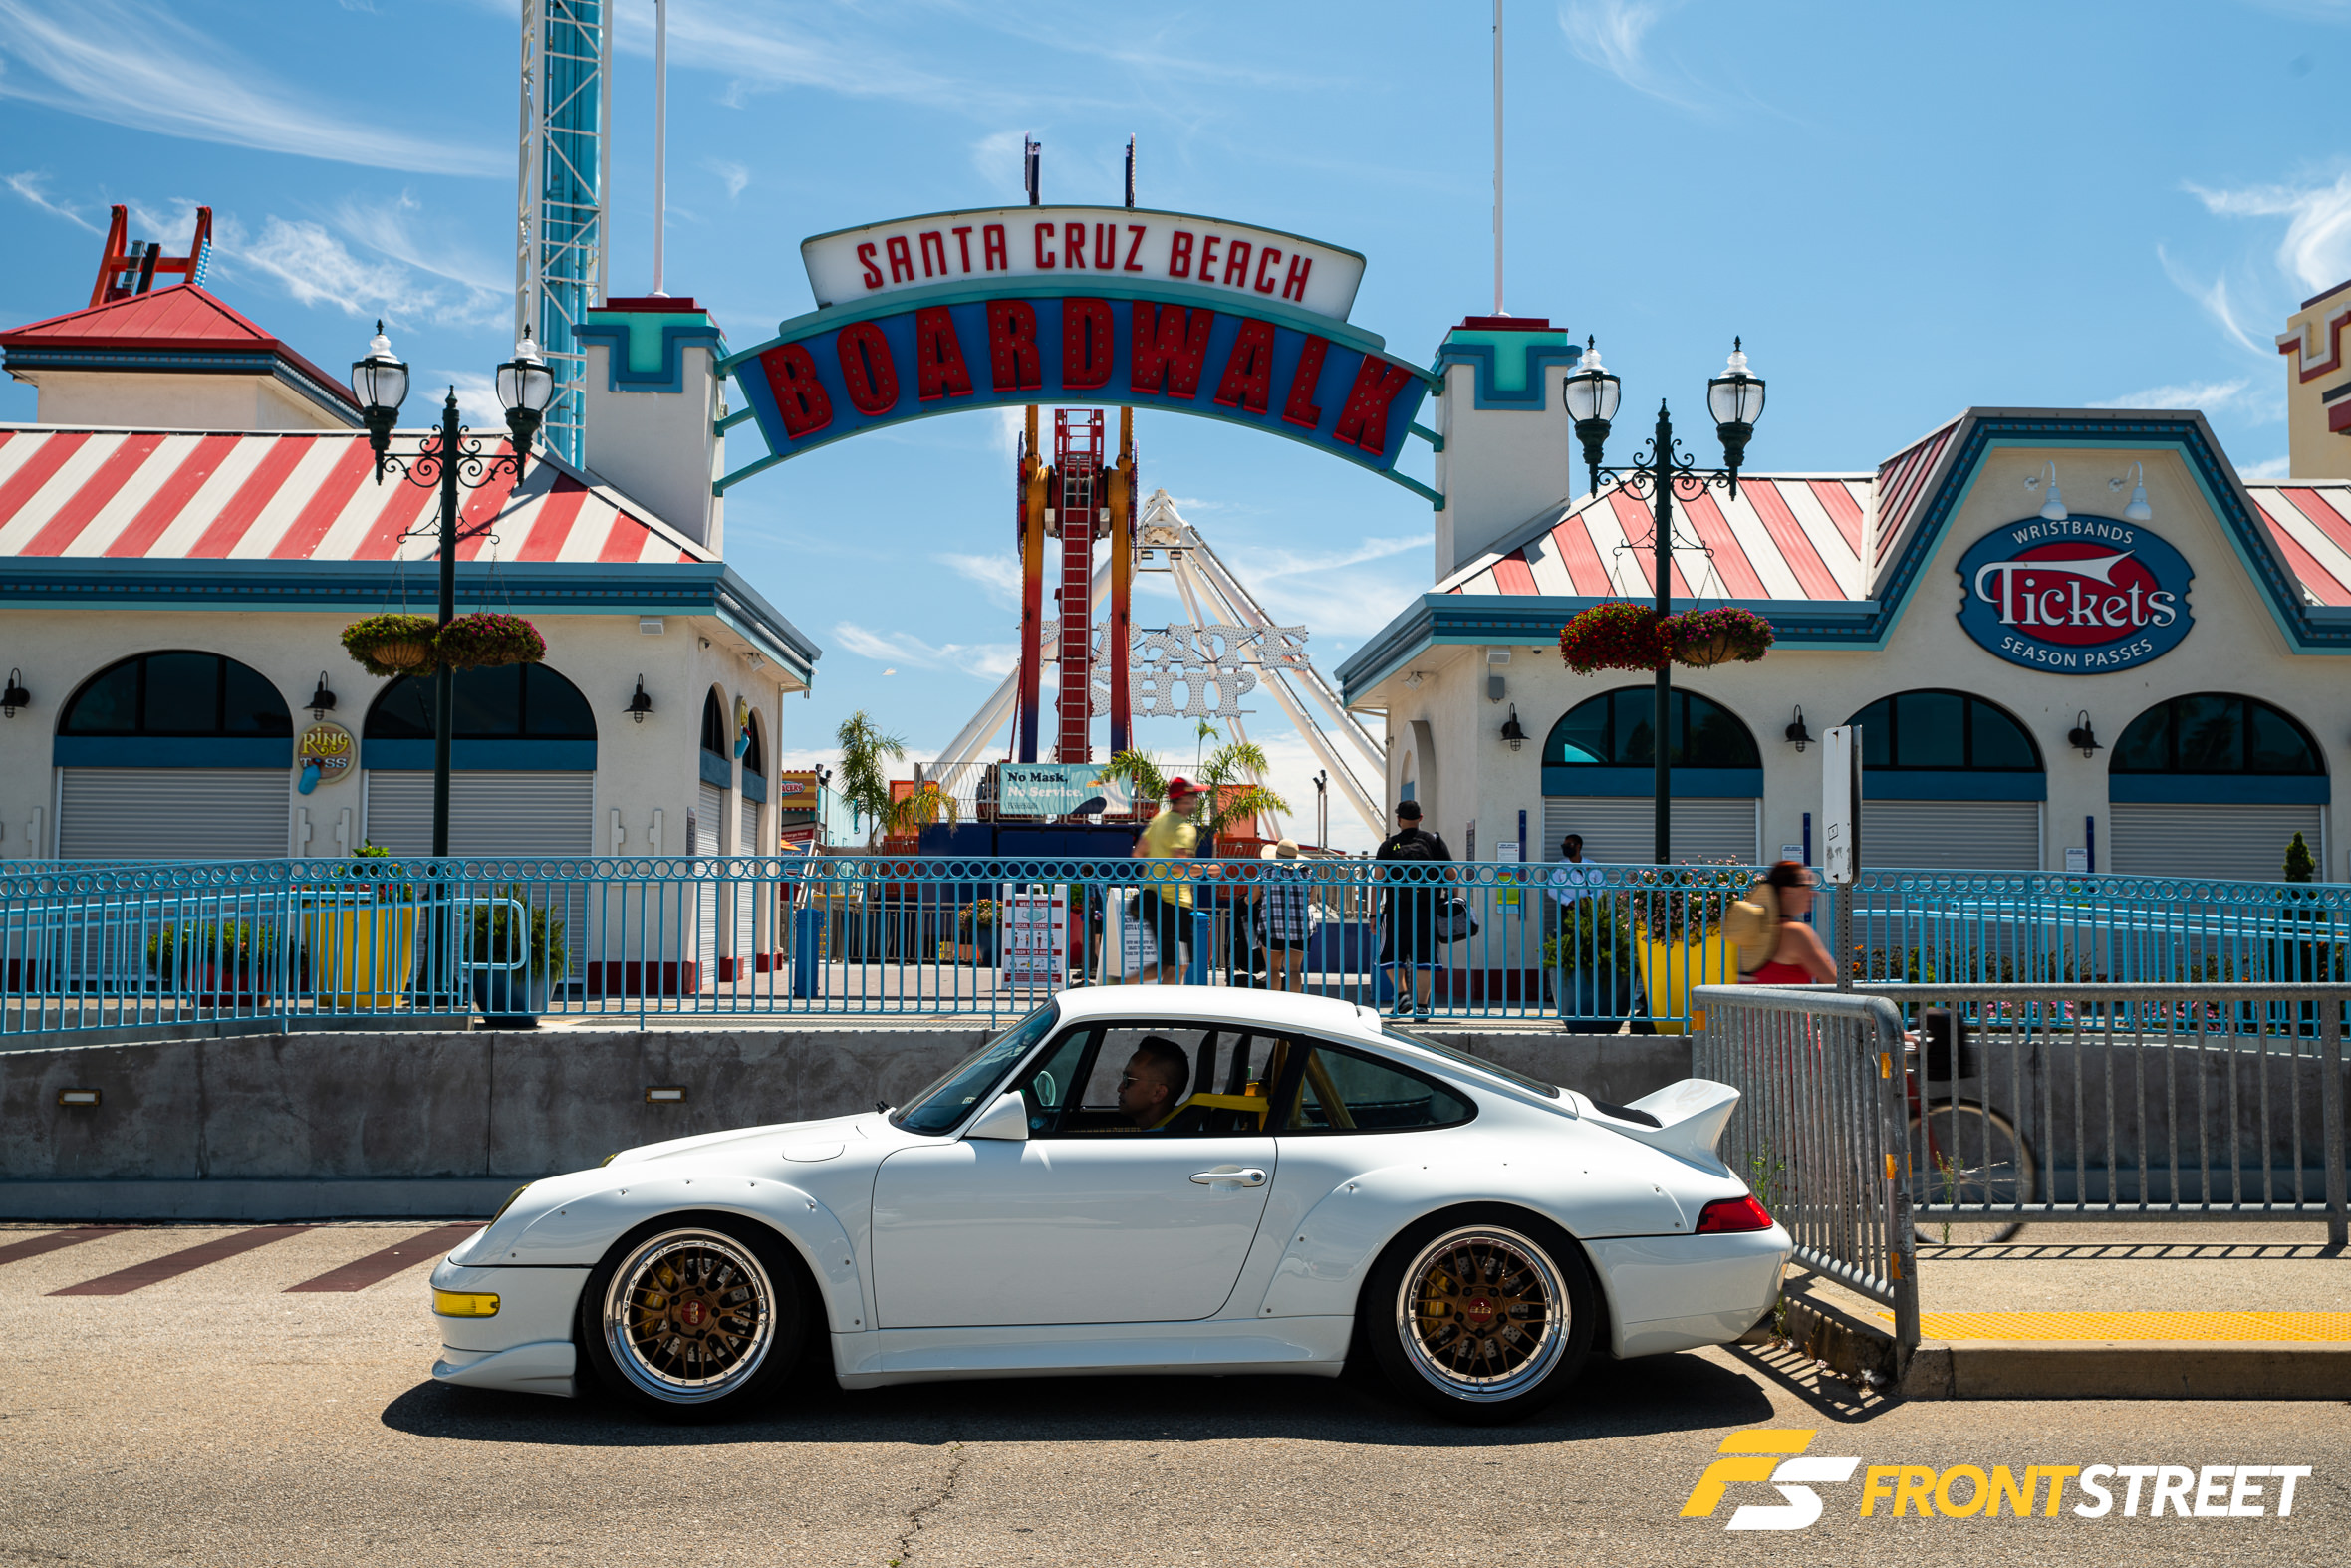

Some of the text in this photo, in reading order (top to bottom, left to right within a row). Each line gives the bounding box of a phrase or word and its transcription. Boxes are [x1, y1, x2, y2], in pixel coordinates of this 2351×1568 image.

[857, 222, 1313, 302] SANTA CRUZ BEACH
[758, 298, 1412, 457] BOARDWALK
[2012, 521, 2134, 545] WRISTBANDS
[1974, 549, 2176, 627] Tickets
[2000, 636, 2153, 667] SEASON PASSES
[782, 784, 803, 793] ACERS
[1007, 772, 1069, 784] No Mask,
[1007, 786, 1084, 797] No Service.
